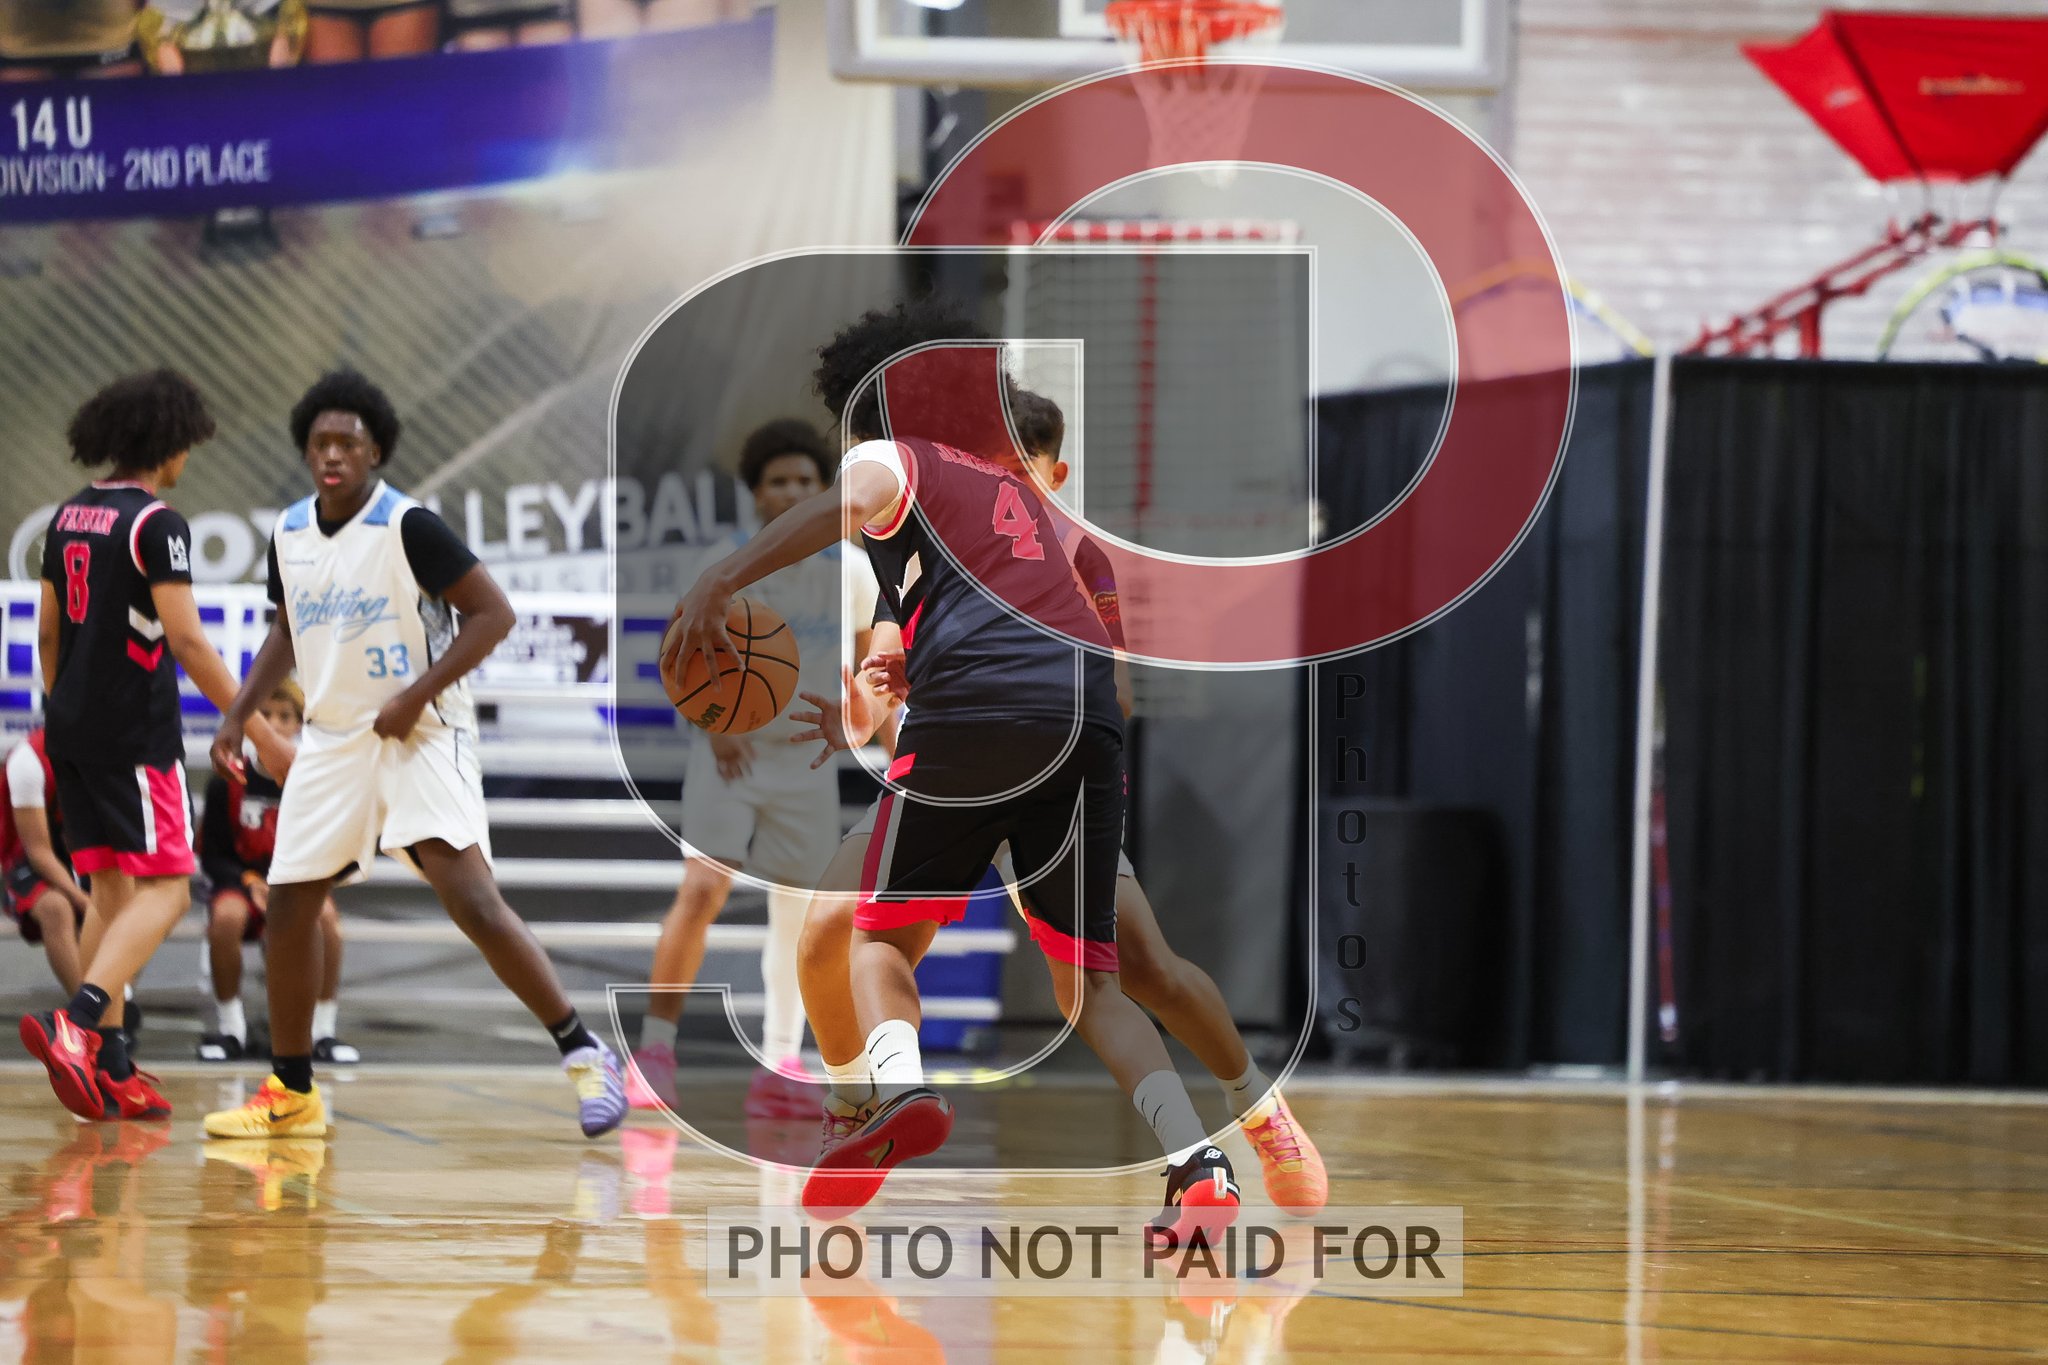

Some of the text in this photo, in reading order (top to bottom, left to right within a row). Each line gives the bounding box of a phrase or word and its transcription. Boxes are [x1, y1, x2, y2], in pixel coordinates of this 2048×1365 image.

[11, 95, 92, 151] 14 U
[123, 147, 180, 190] 2ND
[185, 139, 271, 187] PLACE
[992, 481, 1045, 561] 4
[63, 540, 91, 624] 8
[365, 644, 409, 679] 33
